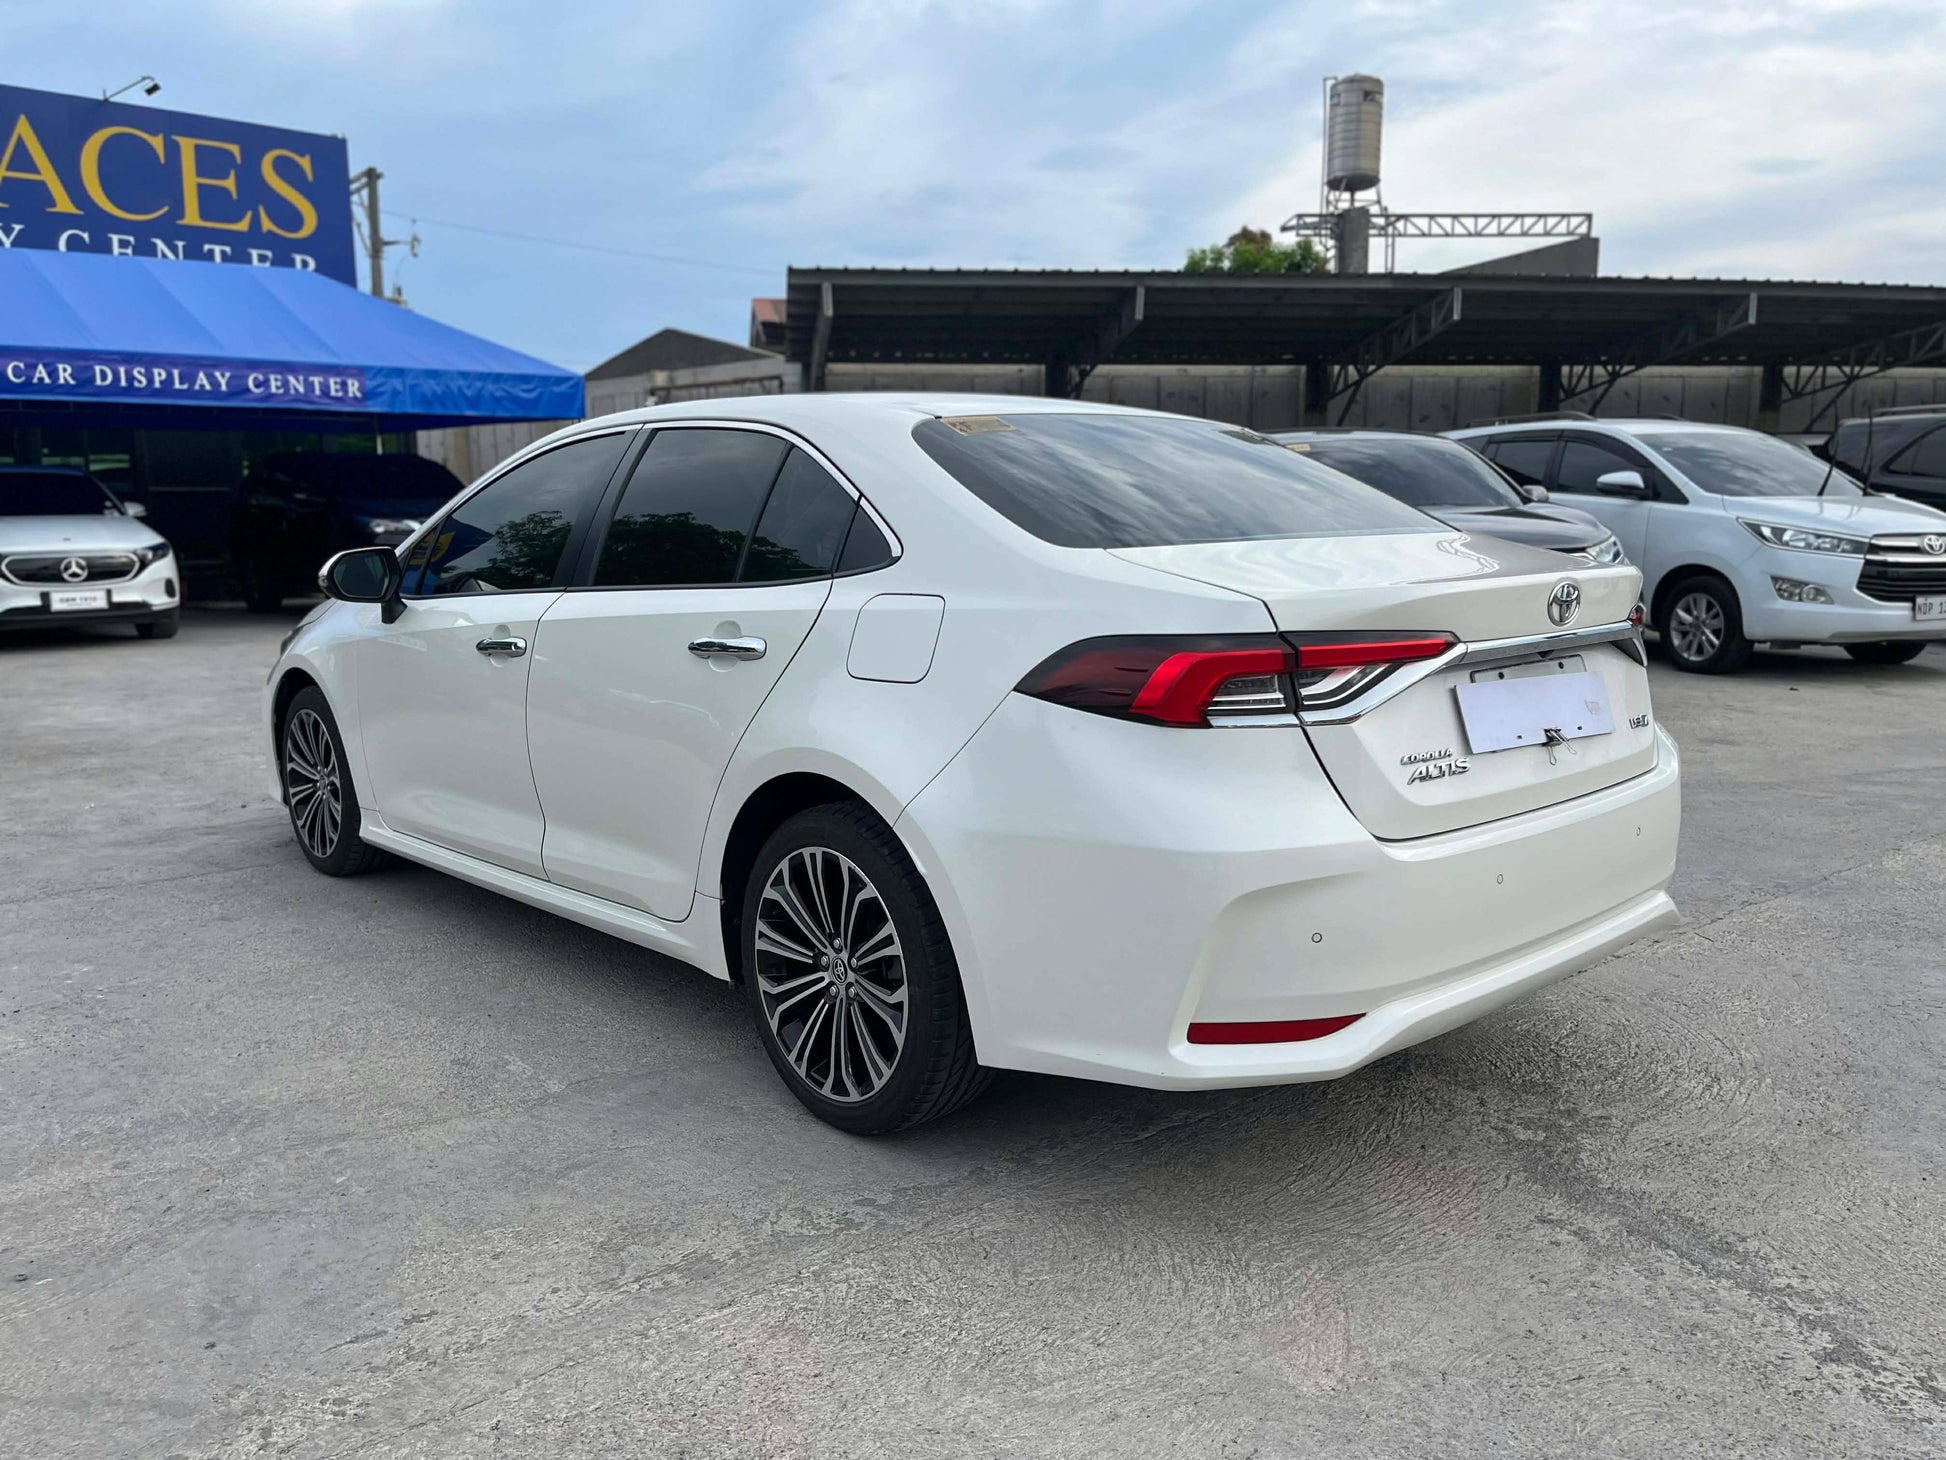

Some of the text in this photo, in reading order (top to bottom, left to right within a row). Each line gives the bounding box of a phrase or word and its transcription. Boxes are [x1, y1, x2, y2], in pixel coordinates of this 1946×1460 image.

[0, 113, 319, 240] ACES
[6, 361, 362, 398] CAR DISPLAY CENTER
[1400, 747, 1453, 765] COROLLA
[1406, 757, 1470, 785] ALTIS
